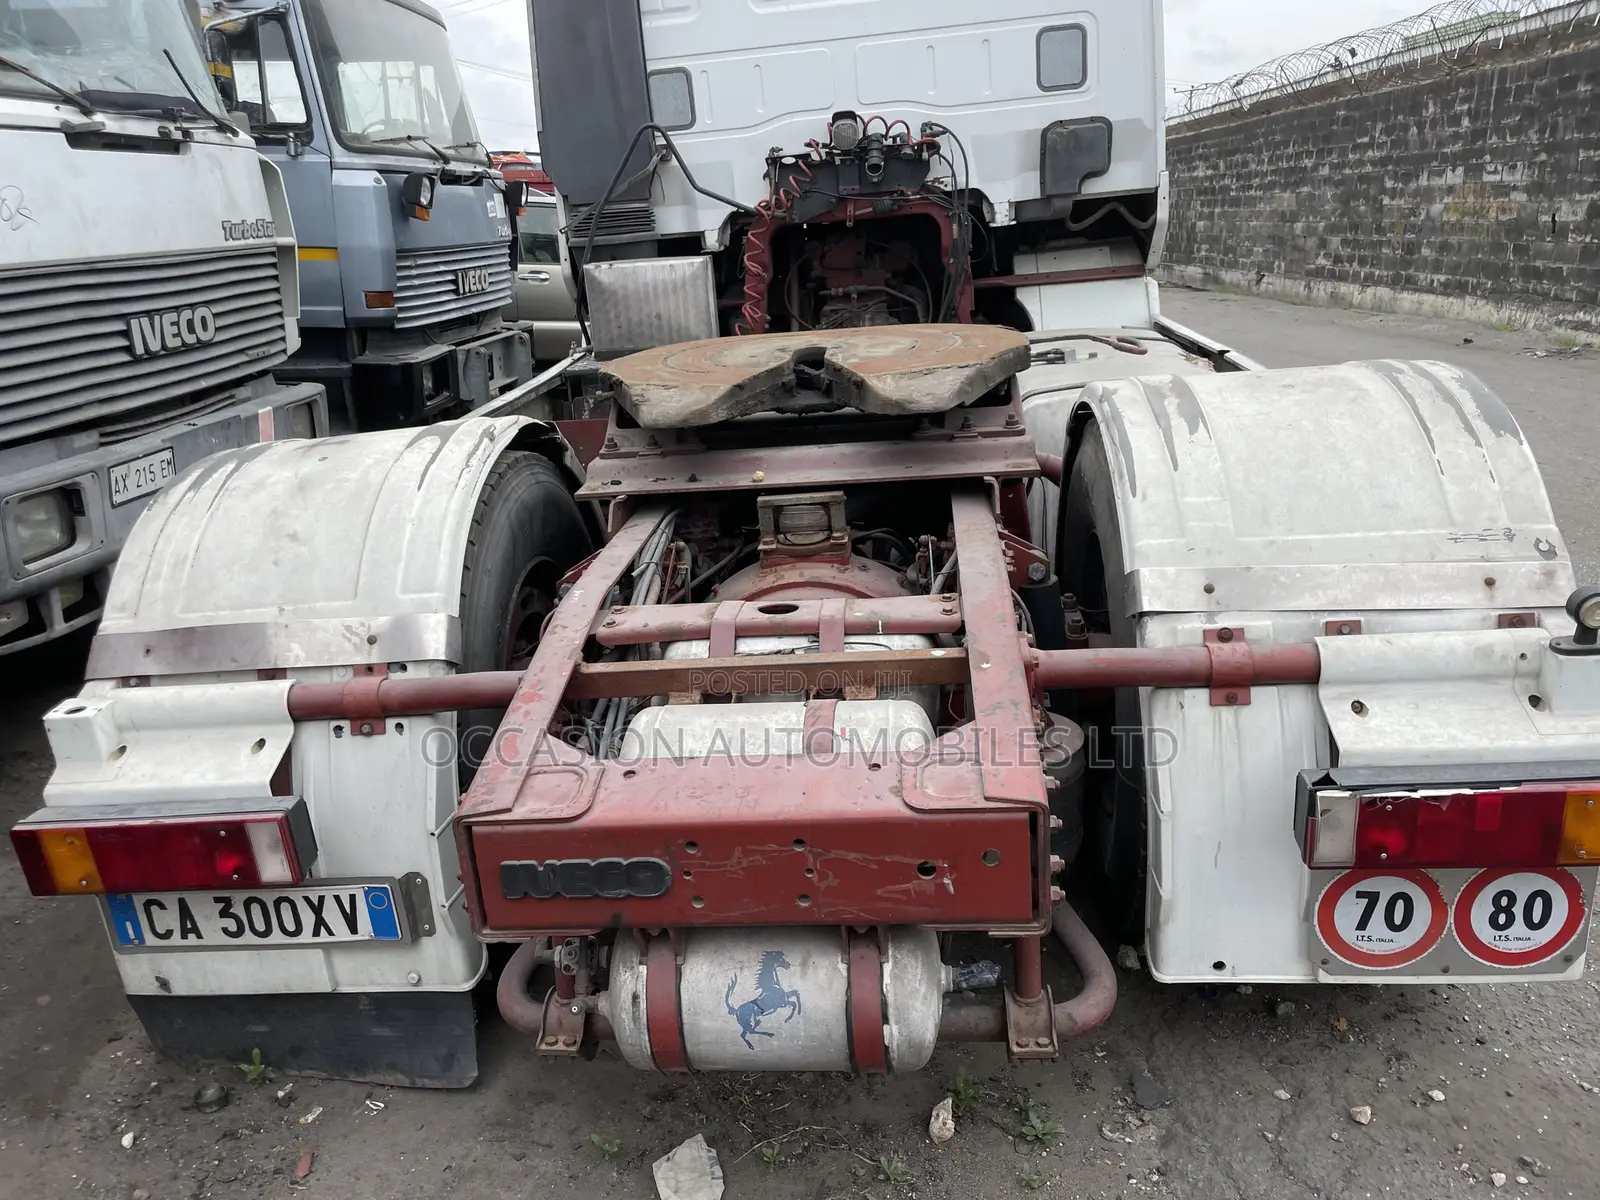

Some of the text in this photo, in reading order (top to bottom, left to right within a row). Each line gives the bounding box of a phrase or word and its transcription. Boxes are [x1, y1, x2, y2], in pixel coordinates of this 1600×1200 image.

[457, 267, 489, 295] IVECO
[128, 305, 216, 357] IVECO
[114, 457, 175, 496] AX 215 EM
[500, 857, 672, 898] IVECO
[143, 893, 359, 940] CA 300XV
[1355, 890, 1415, 933] 70
[1488, 889, 1553, 931] 80
[1493, 934, 1512, 942] I.T.S.
